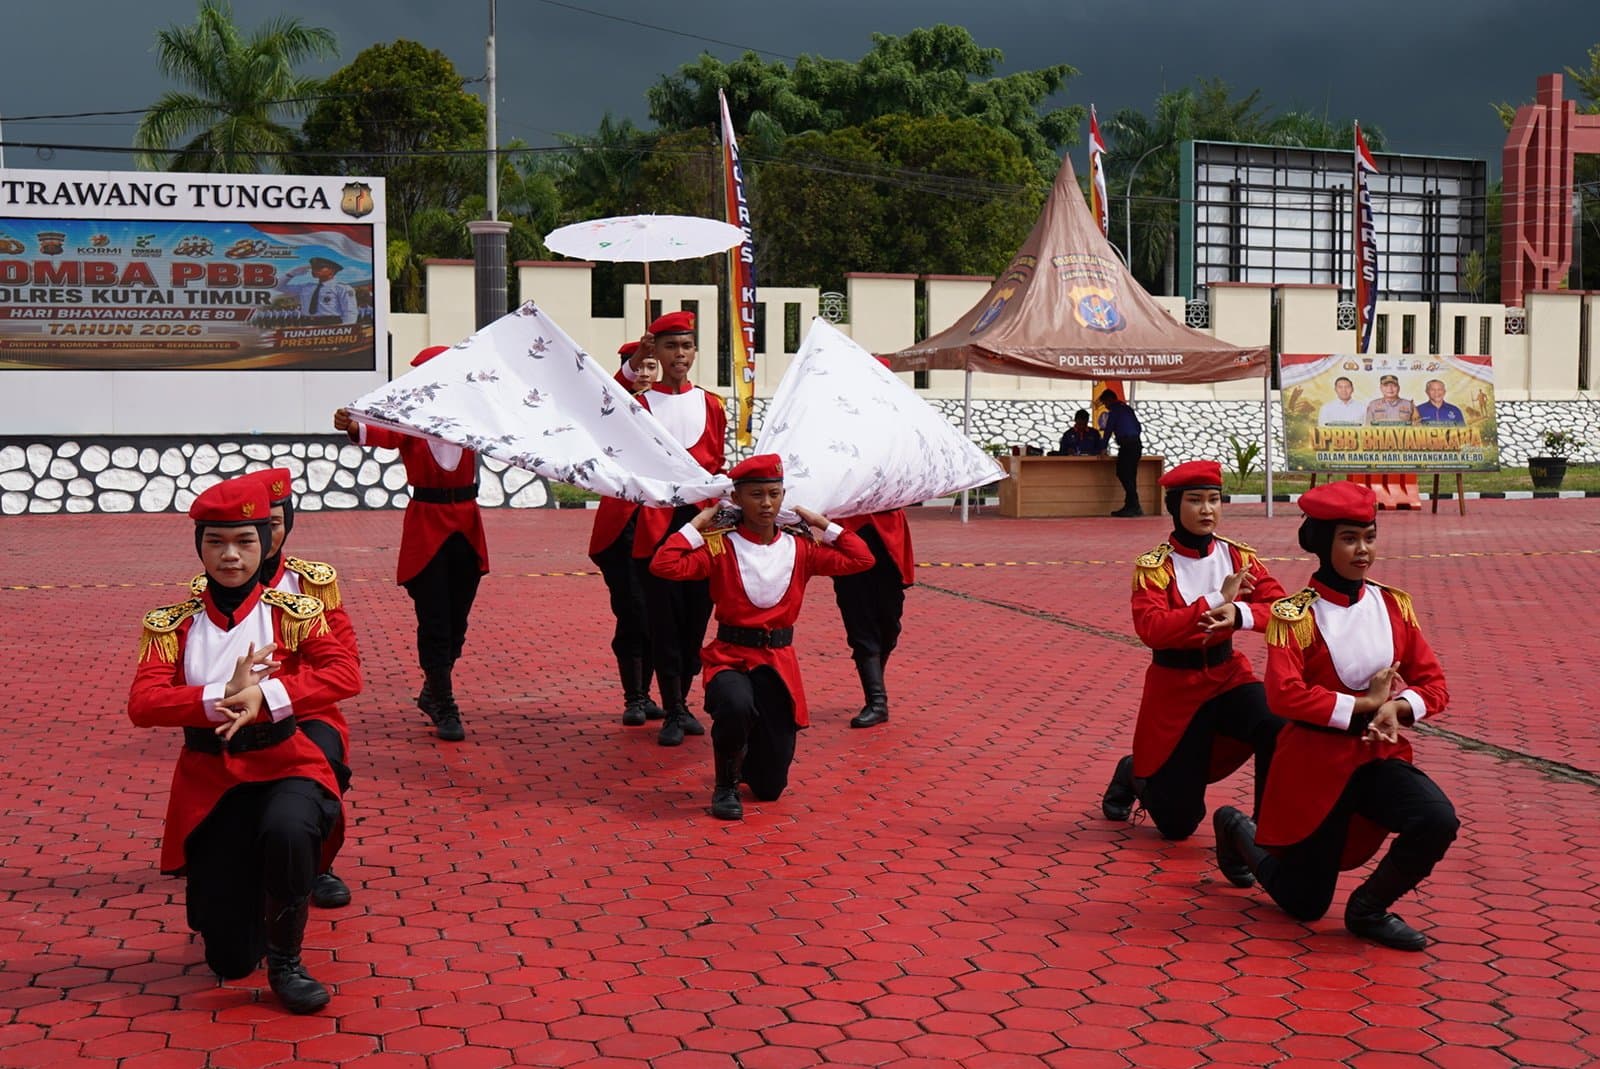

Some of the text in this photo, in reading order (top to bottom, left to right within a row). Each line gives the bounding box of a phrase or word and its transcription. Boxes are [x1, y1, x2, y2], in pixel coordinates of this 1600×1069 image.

[2, 180, 331, 210] TRAWANG TUNGGA
[77, 246, 122, 255] KORMI
[171, 261, 279, 288] PBB
[92, 289, 175, 305] KUTAI
[184, 290, 272, 305] TIMUR
[10, 308, 236, 320] HARI BHAYANGKARA KE 80
[48, 323, 203, 336] TAHUN 2026
[283, 327, 352, 338] TUNJUKKAN
[741, 286, 755, 384] KUTIM
[280, 335, 358, 347] PRESTASIMU
[1059, 355, 1183, 366] POLRES KUTAI TIMUR
[1362, 427, 1483, 451] BHAYANGKARA
[1317, 453, 1346, 461] DALAM
[1348, 453, 1379, 461] RANGKA
[1382, 453, 1400, 461] HARI
[1403, 453, 1459, 461] BHAYANGKARA
